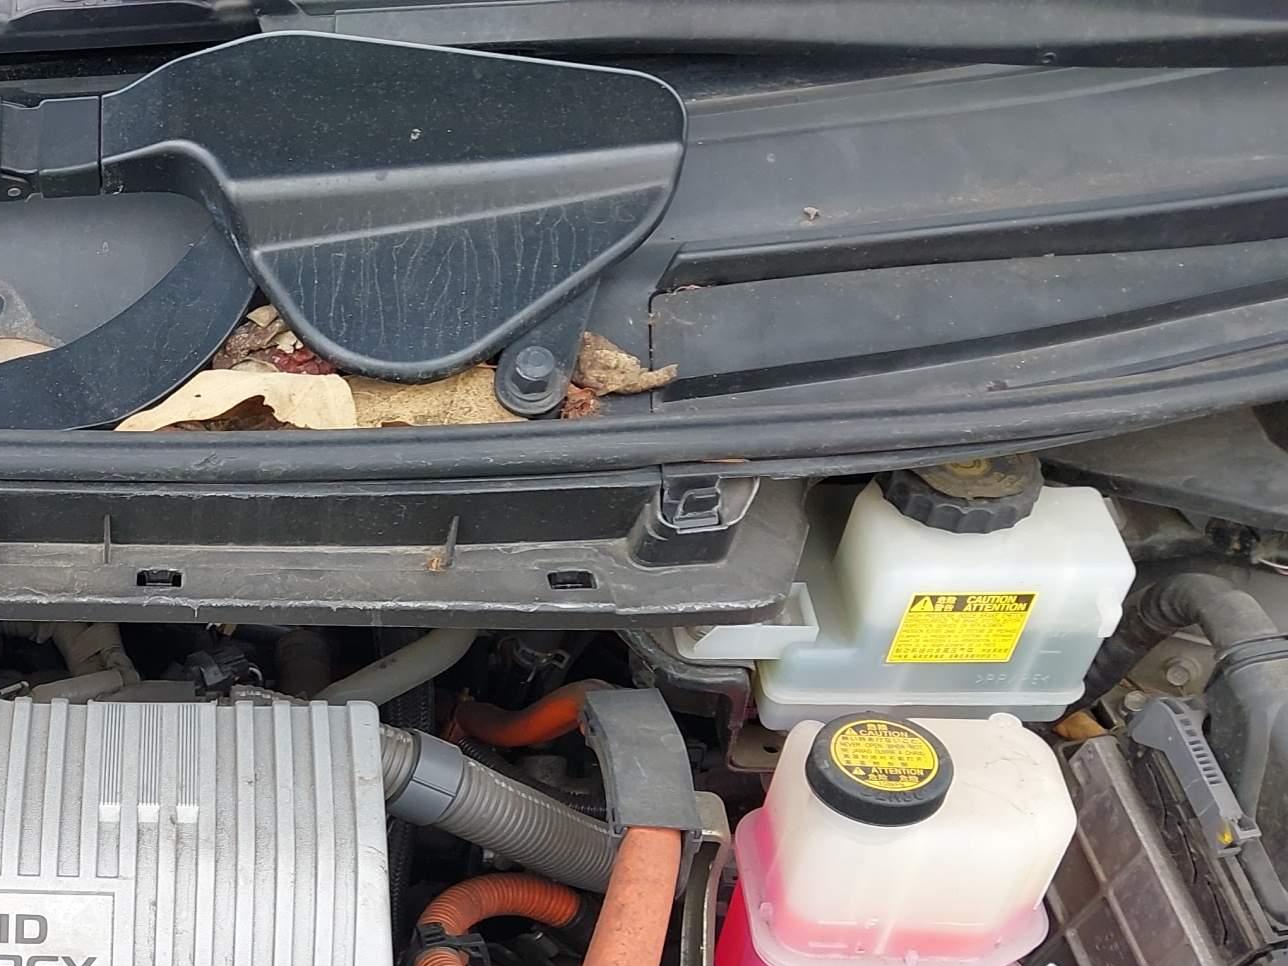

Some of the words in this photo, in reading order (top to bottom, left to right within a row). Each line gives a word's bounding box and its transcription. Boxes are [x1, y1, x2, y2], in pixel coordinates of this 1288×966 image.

[966, 596, 1018, 604] CAUTION
[963, 603, 1027, 611] ATTENTION
[859, 730, 909, 738] CAUTION
[871, 767, 924, 776] ATTENTION
